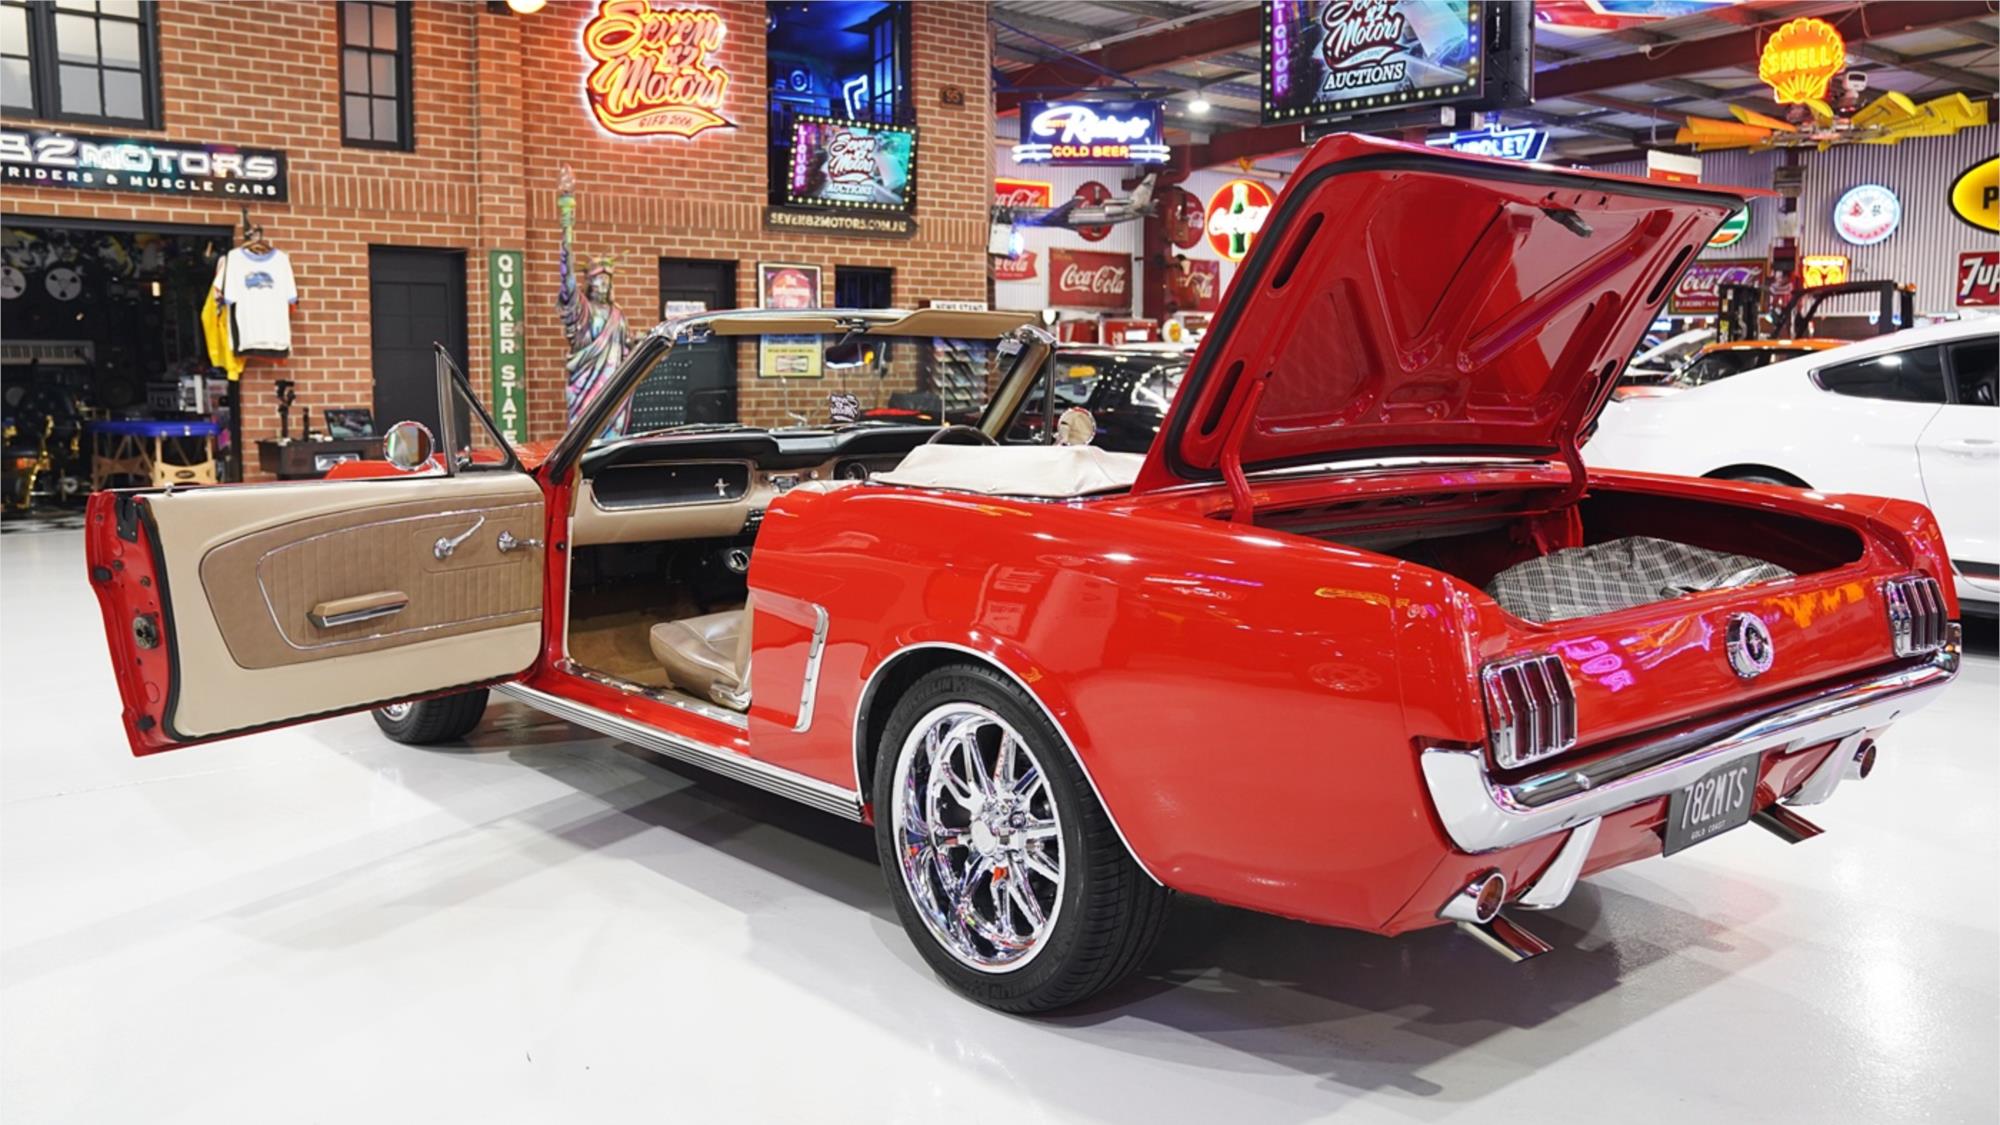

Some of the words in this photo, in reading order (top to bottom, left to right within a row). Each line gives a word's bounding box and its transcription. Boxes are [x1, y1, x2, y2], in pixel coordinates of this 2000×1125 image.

[589, 0, 723, 60] Seven
[1326, 14, 1401, 57] Motors
[1325, 63, 1404, 90] AUCTIONS
[1767, 45, 1832, 75] SHELL
[592, 55, 728, 113] Motors
[1052, 145, 1089, 158] COLD
[1092, 145, 1129, 158] BEER
[0, 165, 94, 184] RIDERS
[106, 173, 119, 186] &
[130, 175, 214, 193] MUSCLE
[224, 182, 278, 197] CARS
[1060, 263, 1125, 294] Coca-Cola
[498, 254, 515, 355] QUAKER
[501, 365, 518, 448] STATE
[1681, 766, 1748, 829] 782MTS
